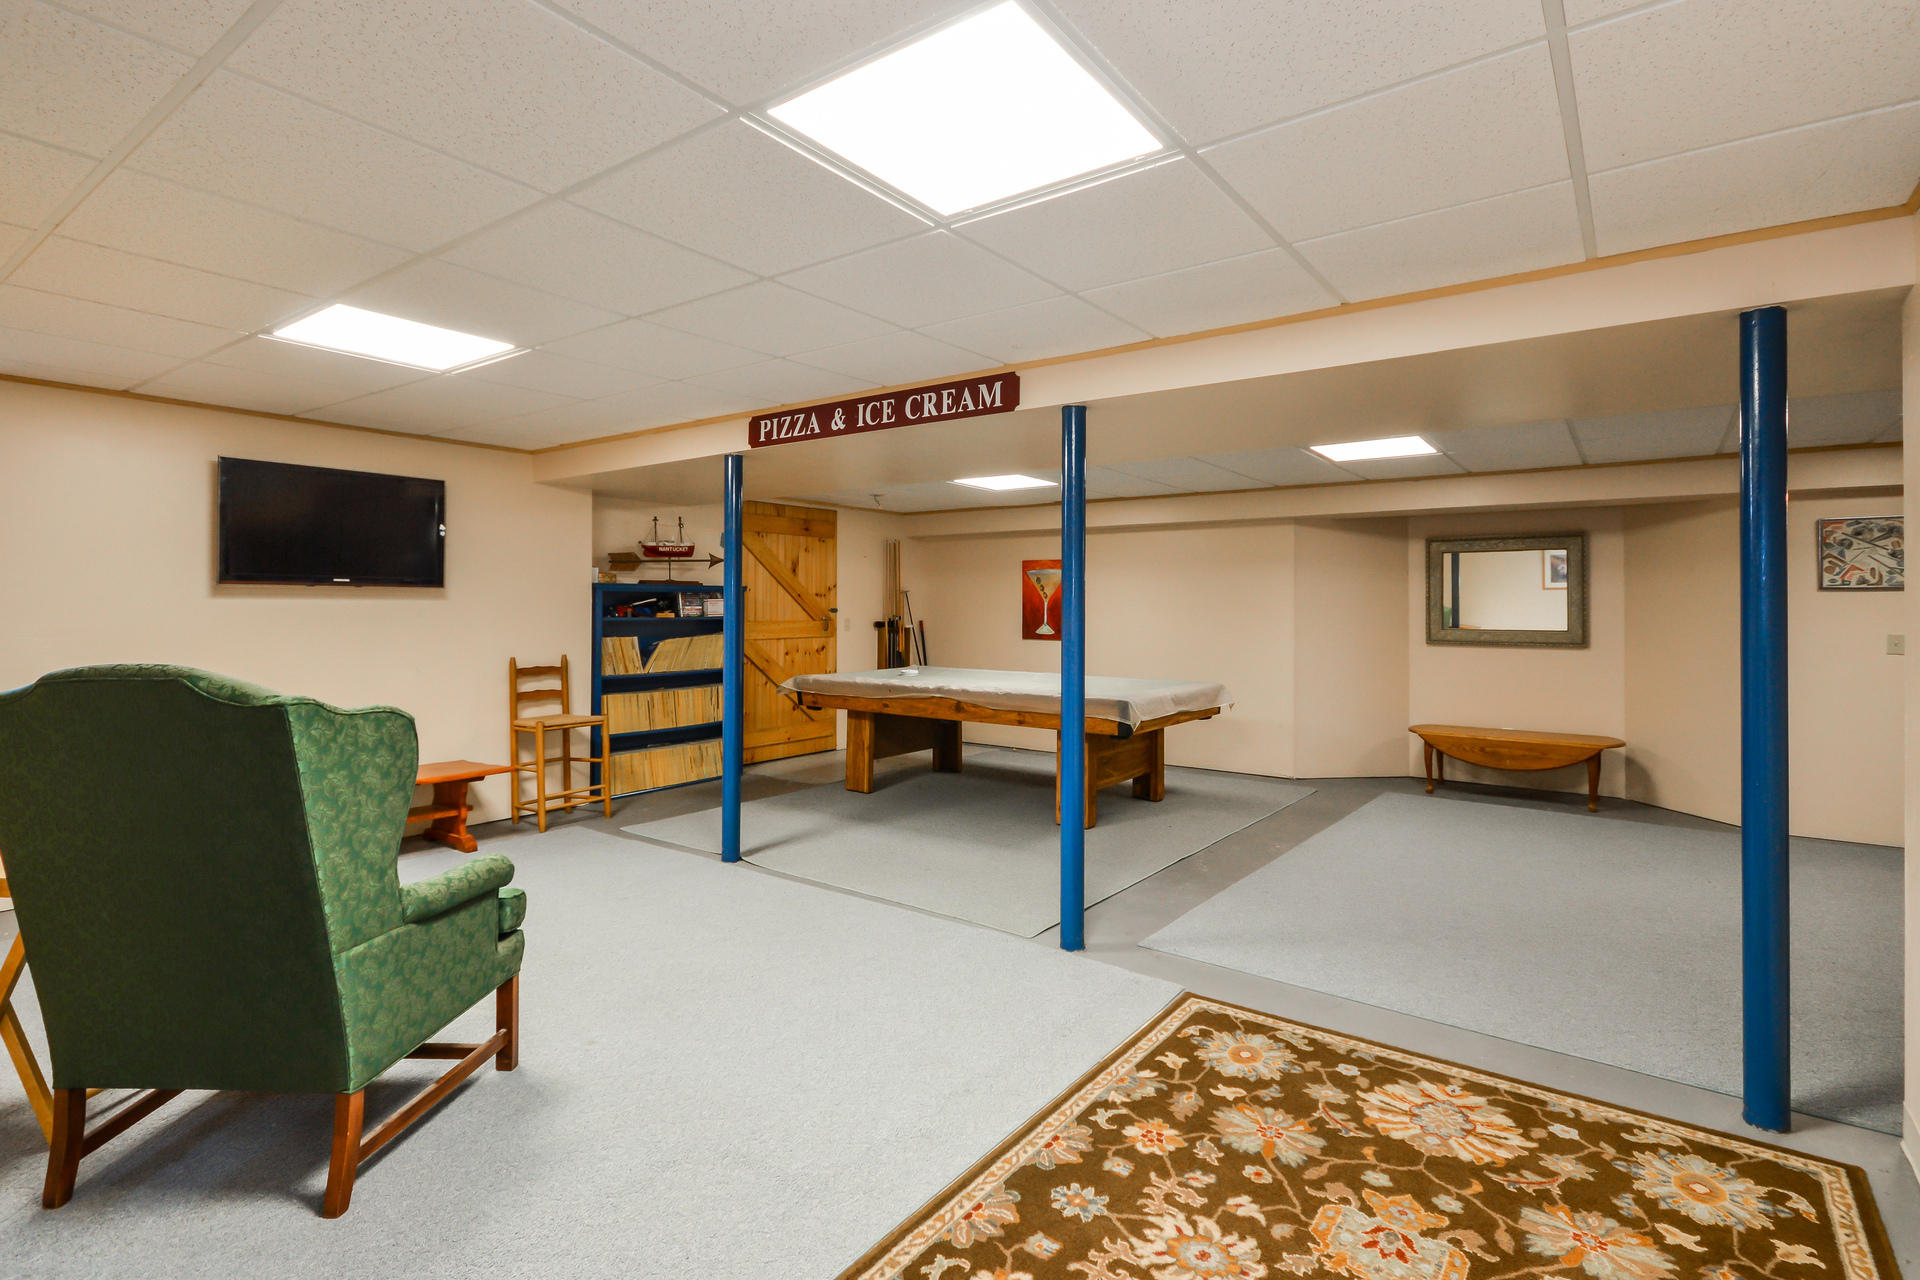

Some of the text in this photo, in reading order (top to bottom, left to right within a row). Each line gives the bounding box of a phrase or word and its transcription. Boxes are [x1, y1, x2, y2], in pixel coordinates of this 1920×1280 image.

[759, 380, 1004, 442] PIZZA & ICE CREAM
